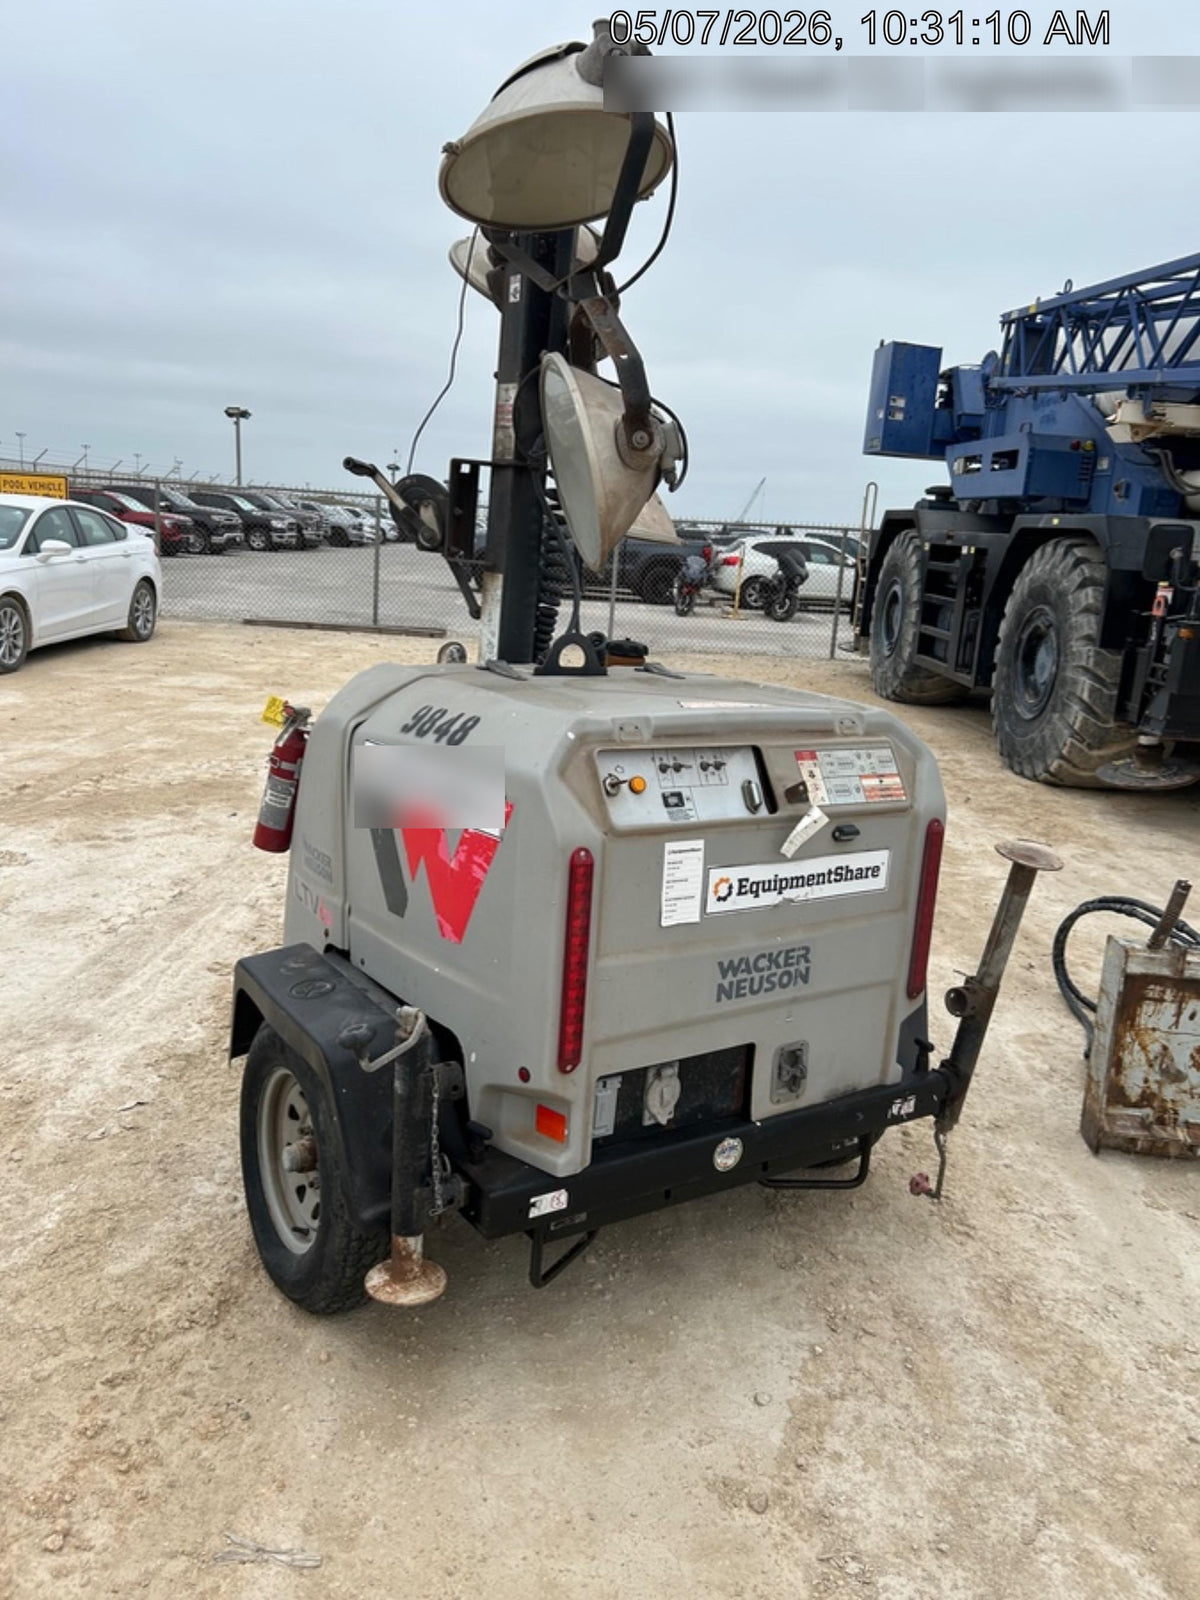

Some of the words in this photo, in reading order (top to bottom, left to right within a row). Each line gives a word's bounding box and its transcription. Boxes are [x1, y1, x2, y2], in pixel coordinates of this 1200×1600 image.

[3, 479, 26, 490] POOL
[29, 480, 63, 491] VEHICLE
[400, 704, 481, 746] 9848
[736, 864, 881, 898] EquipmentShare
[717, 945, 812, 980] WACKER
[715, 965, 811, 1003] NEUSON
